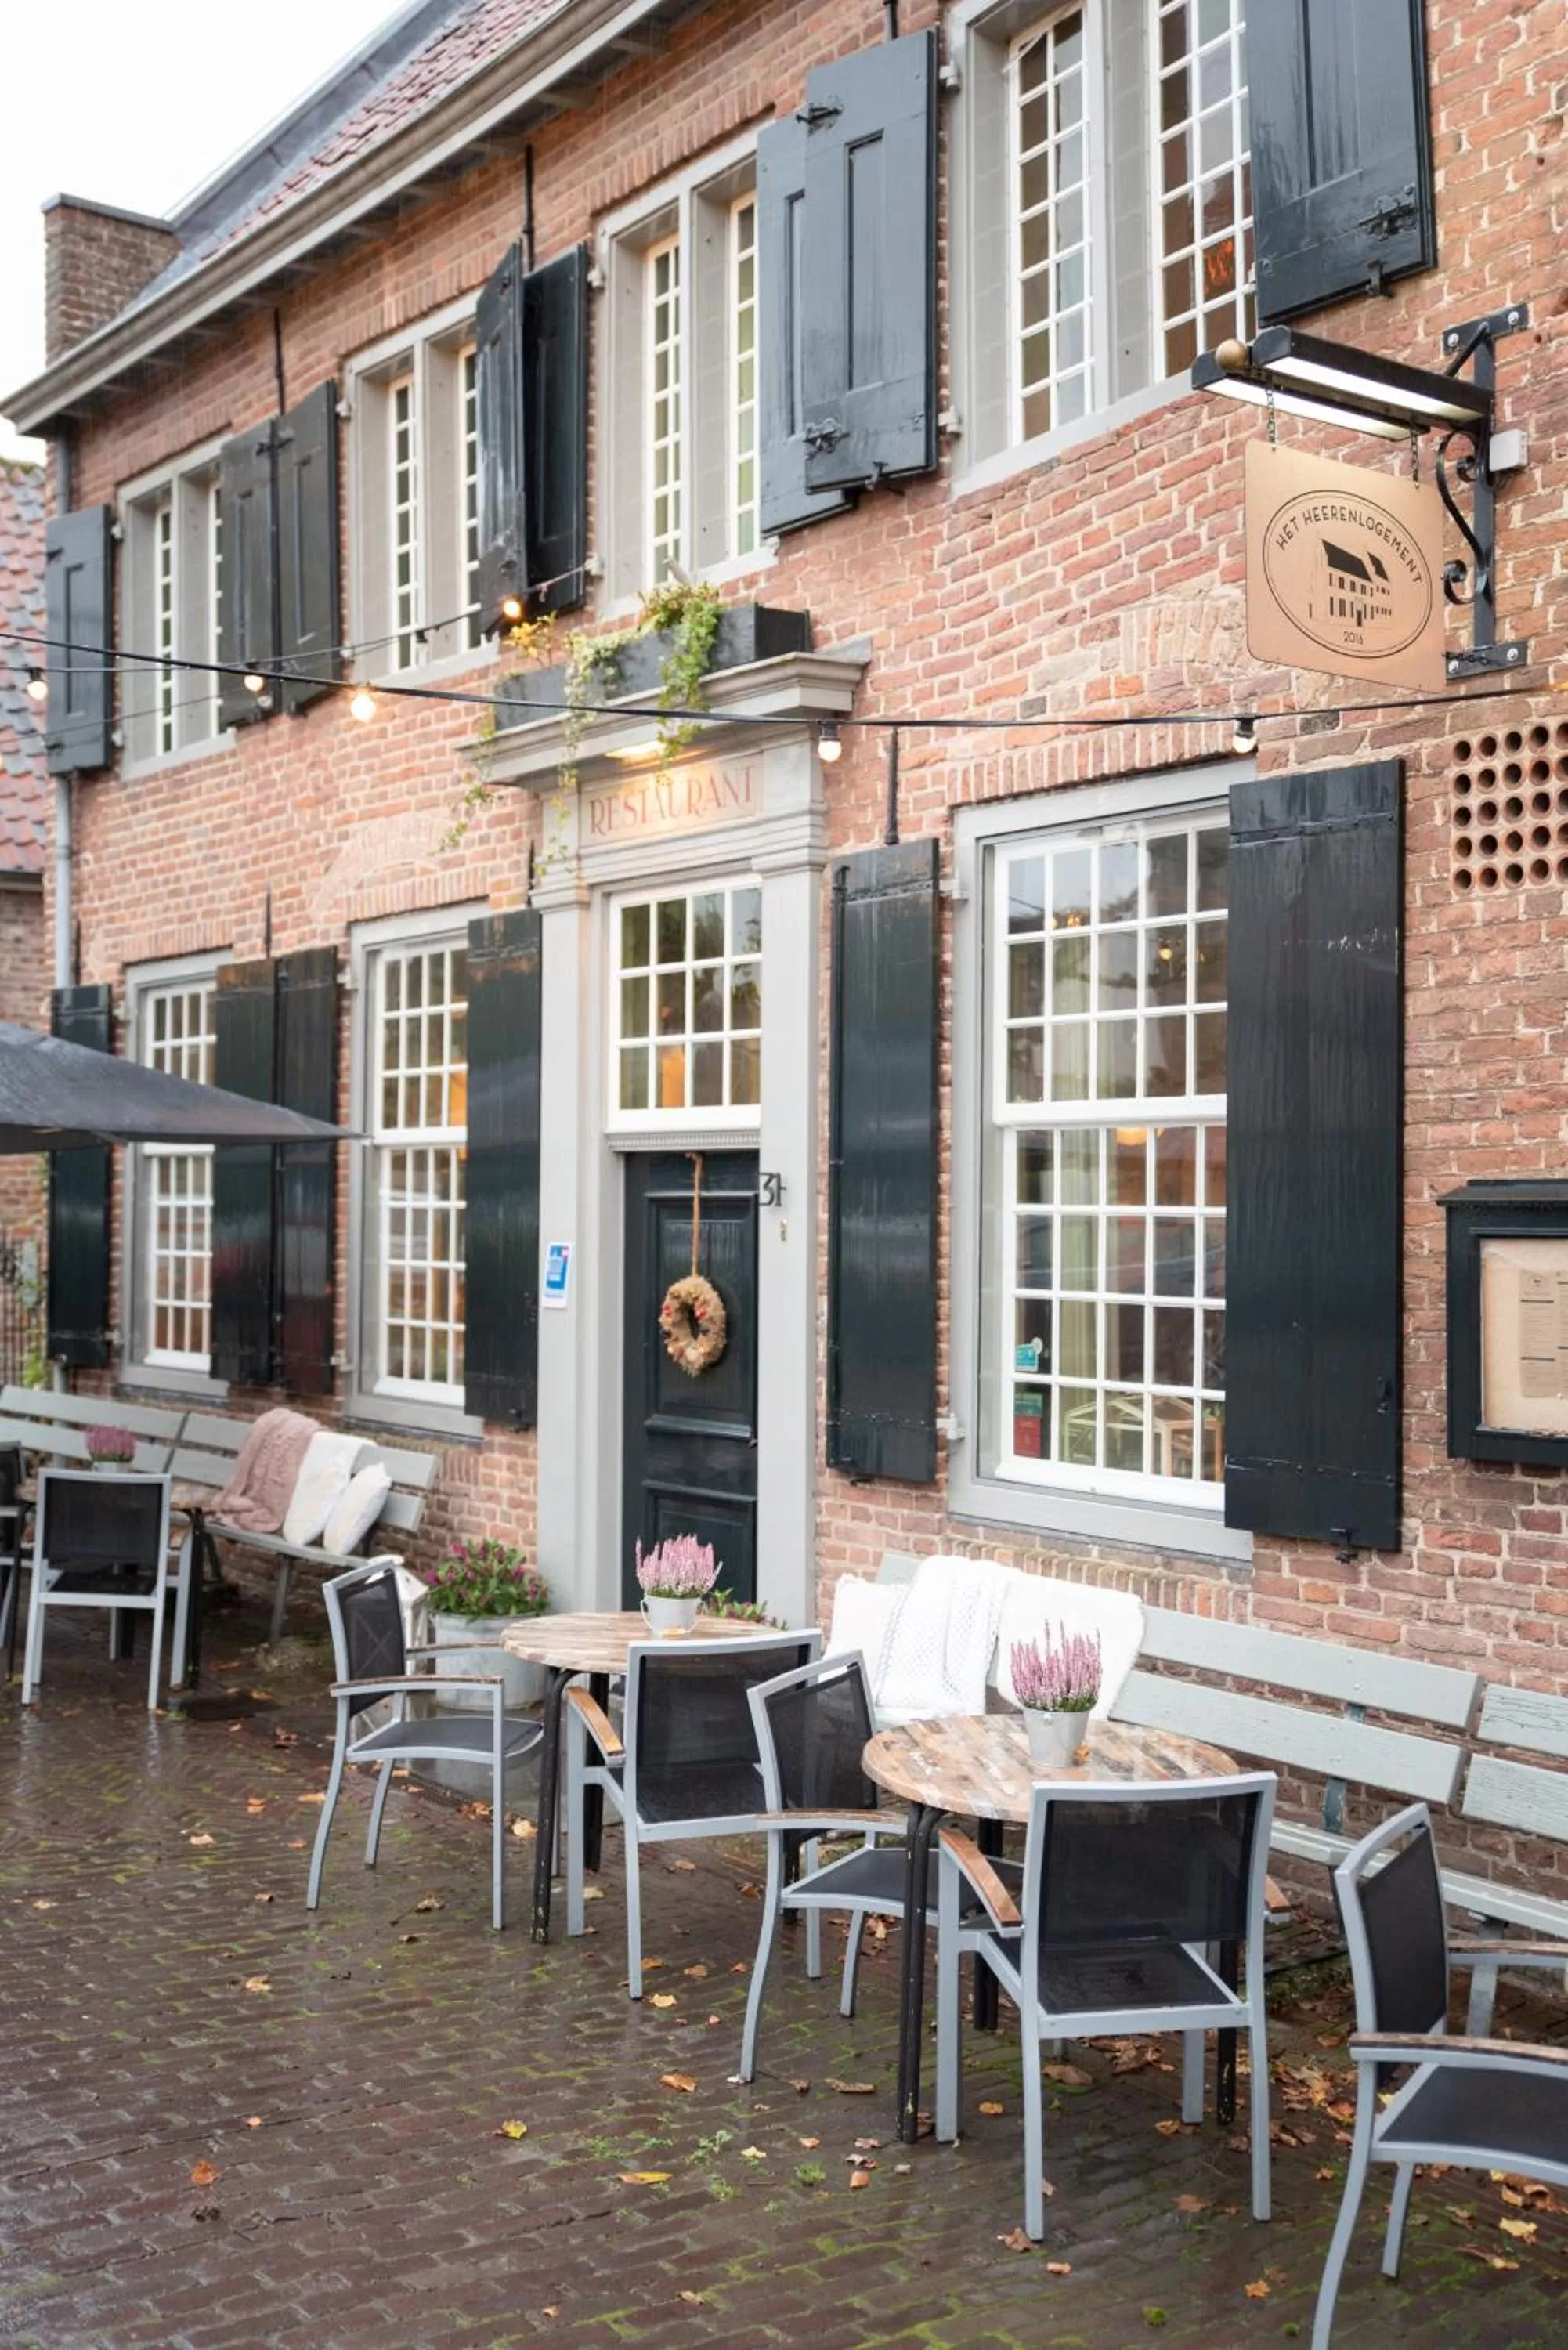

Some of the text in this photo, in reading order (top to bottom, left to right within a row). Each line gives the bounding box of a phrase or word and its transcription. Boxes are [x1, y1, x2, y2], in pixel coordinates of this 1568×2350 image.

[1276, 505, 1423, 584] HET HEERENLOGEMENT
[589, 766, 754, 836] RESTAURANT
